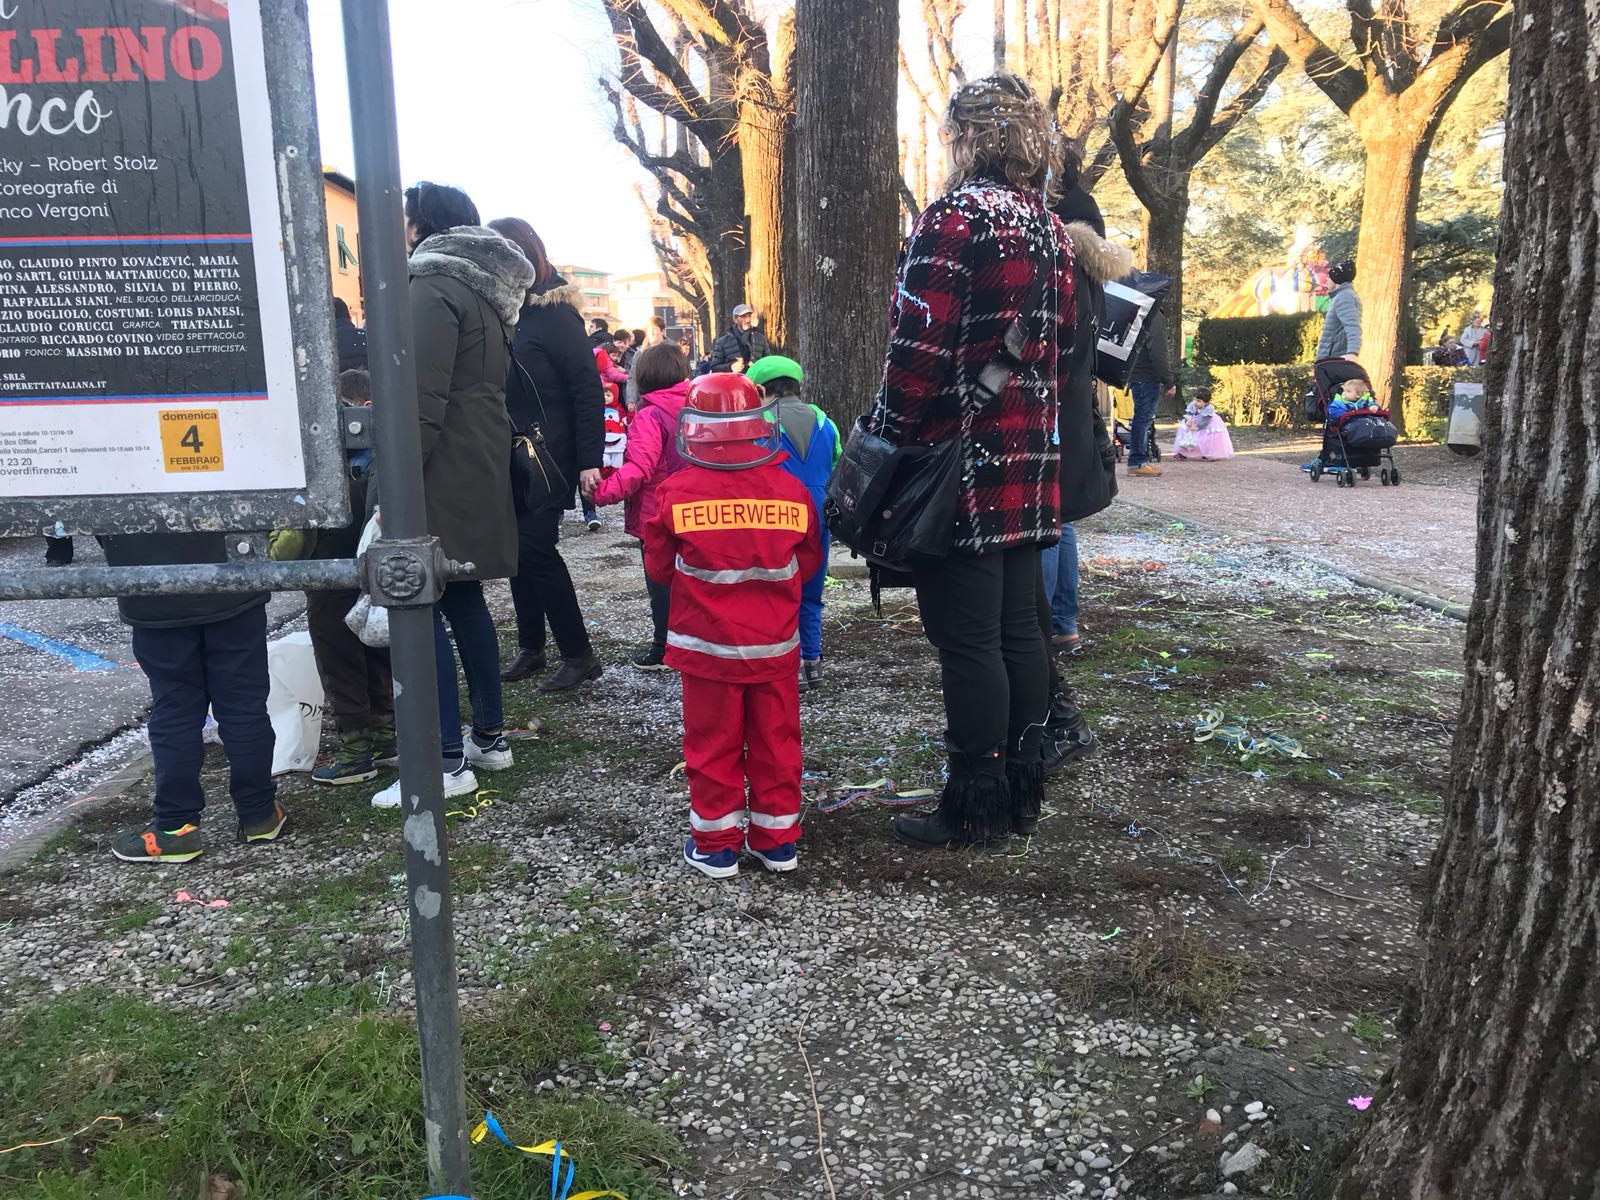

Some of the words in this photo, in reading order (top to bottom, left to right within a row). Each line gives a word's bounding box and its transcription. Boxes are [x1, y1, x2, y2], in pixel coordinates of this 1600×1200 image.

[0, 25, 223, 84] LLINO
[47, 156, 108, 172] Robert
[113, 155, 158, 171] Stolz
[101, 179, 118, 194] di
[37, 202, 110, 221] Vergoni
[19, 258, 73, 269] CLAUDIO
[78, 257, 117, 268] PINTO
[122, 255, 195, 267] KOVAČEVIĆ,
[199, 255, 239, 266] MARIA
[16, 271, 56, 282] SARTI,
[59, 270, 102, 281] GIULIA
[105, 269, 190, 280] MATTARUCCO,
[193, 268, 240, 279] MATTIA
[34, 282, 117, 294] ALESSANDRO,
[124, 282, 164, 293] SILVIA
[172, 281, 186, 292] DI
[193, 280, 241, 292] PIERRO,
[3, 296, 72, 307] RAFFAELLA
[75, 296, 113, 306] SIANI.
[115, 296, 133, 304] NEL
[136, 295, 168, 304] RUOLO
[171, 294, 243, 303] DELL'ARCIDUCA:
[0, 310, 22, 320] ZIO
[26, 309, 92, 320] BOGLIOLO,
[95, 307, 154, 319] COSTUMI:
[157, 306, 194, 318] LORIS
[197, 305, 244, 317] DANESI,
[0, 322, 53, 333] CLAUDIO
[59, 321, 114, 332] CORUCCI
[122, 320, 163, 329] GRAFICA:
[171, 319, 233, 330] THATSALL
[41, 334, 104, 345] RICCARDO
[107, 333, 154, 344] COVINO
[156, 332, 184, 341] VIDEO
[186, 331, 247, 340] SPETTACOLO:
[0, 348, 21, 358] RIO
[25, 347, 63, 357] FONICO:
[65, 346, 122, 357] MASSIMO
[125, 346, 140, 356] DI
[143, 345, 183, 356] BACCO
[185, 344, 248, 354] ELETTRICISTA:
[3, 373, 26, 381] SRLS
[162, 411, 217, 421] domenica
[18, 438, 38, 446] Office
[180, 425, 204, 453] 4
[7, 458, 19, 467] 23
[21, 457, 33, 466] 20
[170, 456, 221, 465] FEBBRAIO
[681, 503, 800, 527] FEUERWEHR
